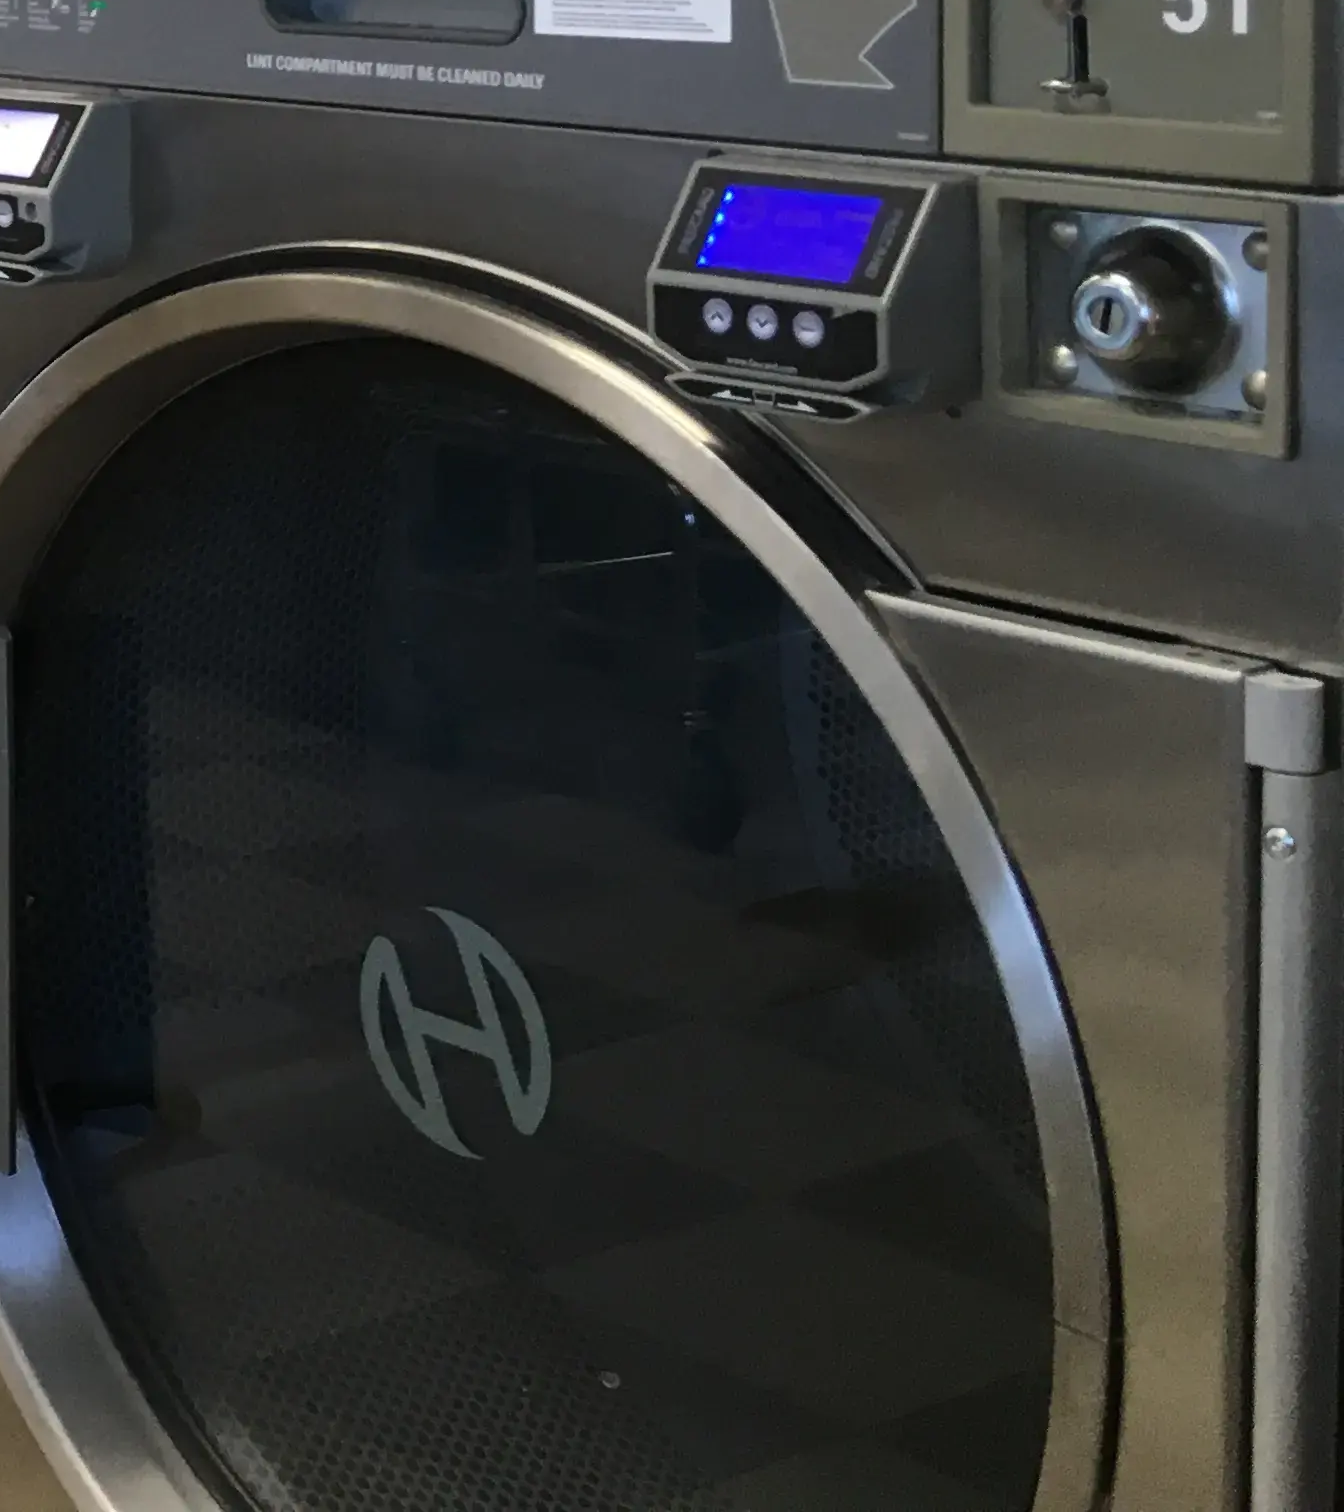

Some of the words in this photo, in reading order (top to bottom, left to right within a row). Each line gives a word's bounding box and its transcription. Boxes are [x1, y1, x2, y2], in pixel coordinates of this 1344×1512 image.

[375, 61, 415, 81] MUST
[416, 64, 435, 82] BE
[436, 66, 502, 88] CLEANED
